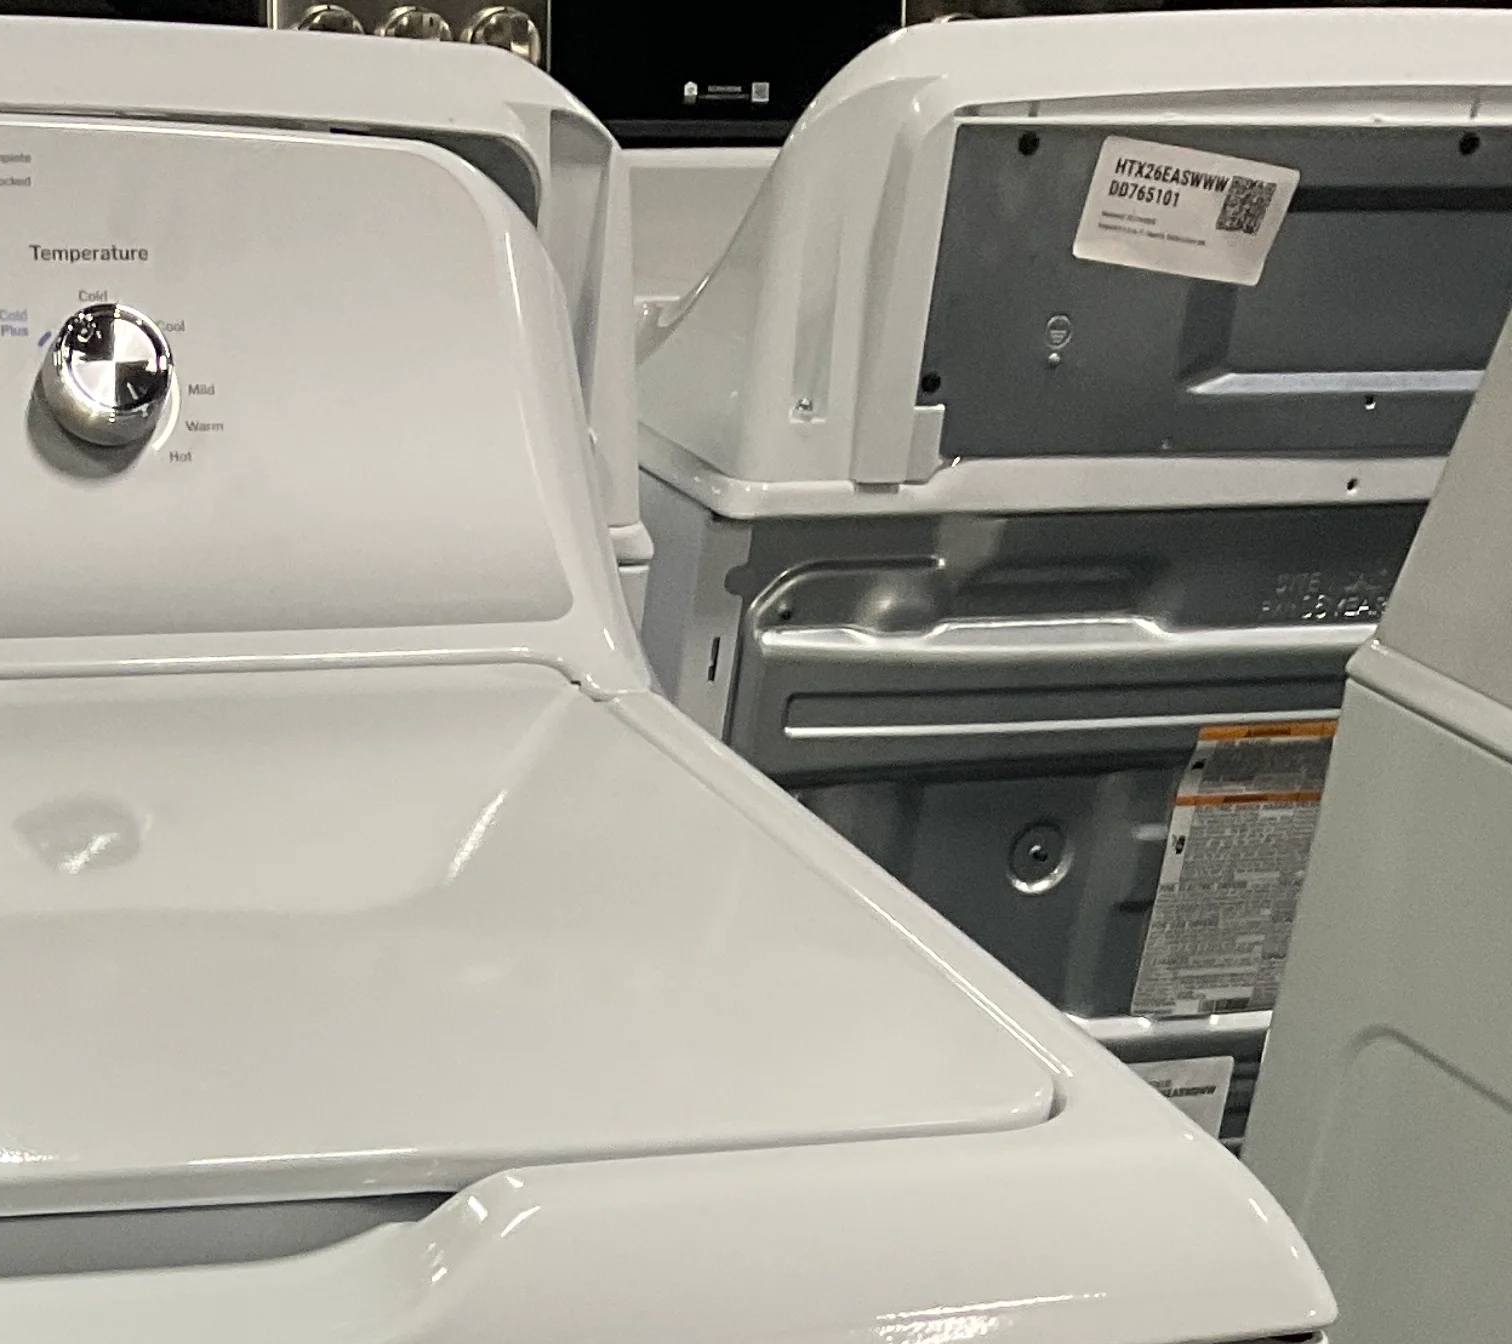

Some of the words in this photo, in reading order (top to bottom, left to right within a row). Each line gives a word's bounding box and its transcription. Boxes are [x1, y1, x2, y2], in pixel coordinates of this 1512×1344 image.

[1115, 157, 1230, 193] HTX26EASWWW
[29, 245, 149, 263] Temperature
[0, 309, 28, 323] Cold
[0, 325, 29, 337] Plus
[188, 384, 215, 396] Mild
[186, 421, 224, 432] Warm
[170, 451, 192, 463] Hot
